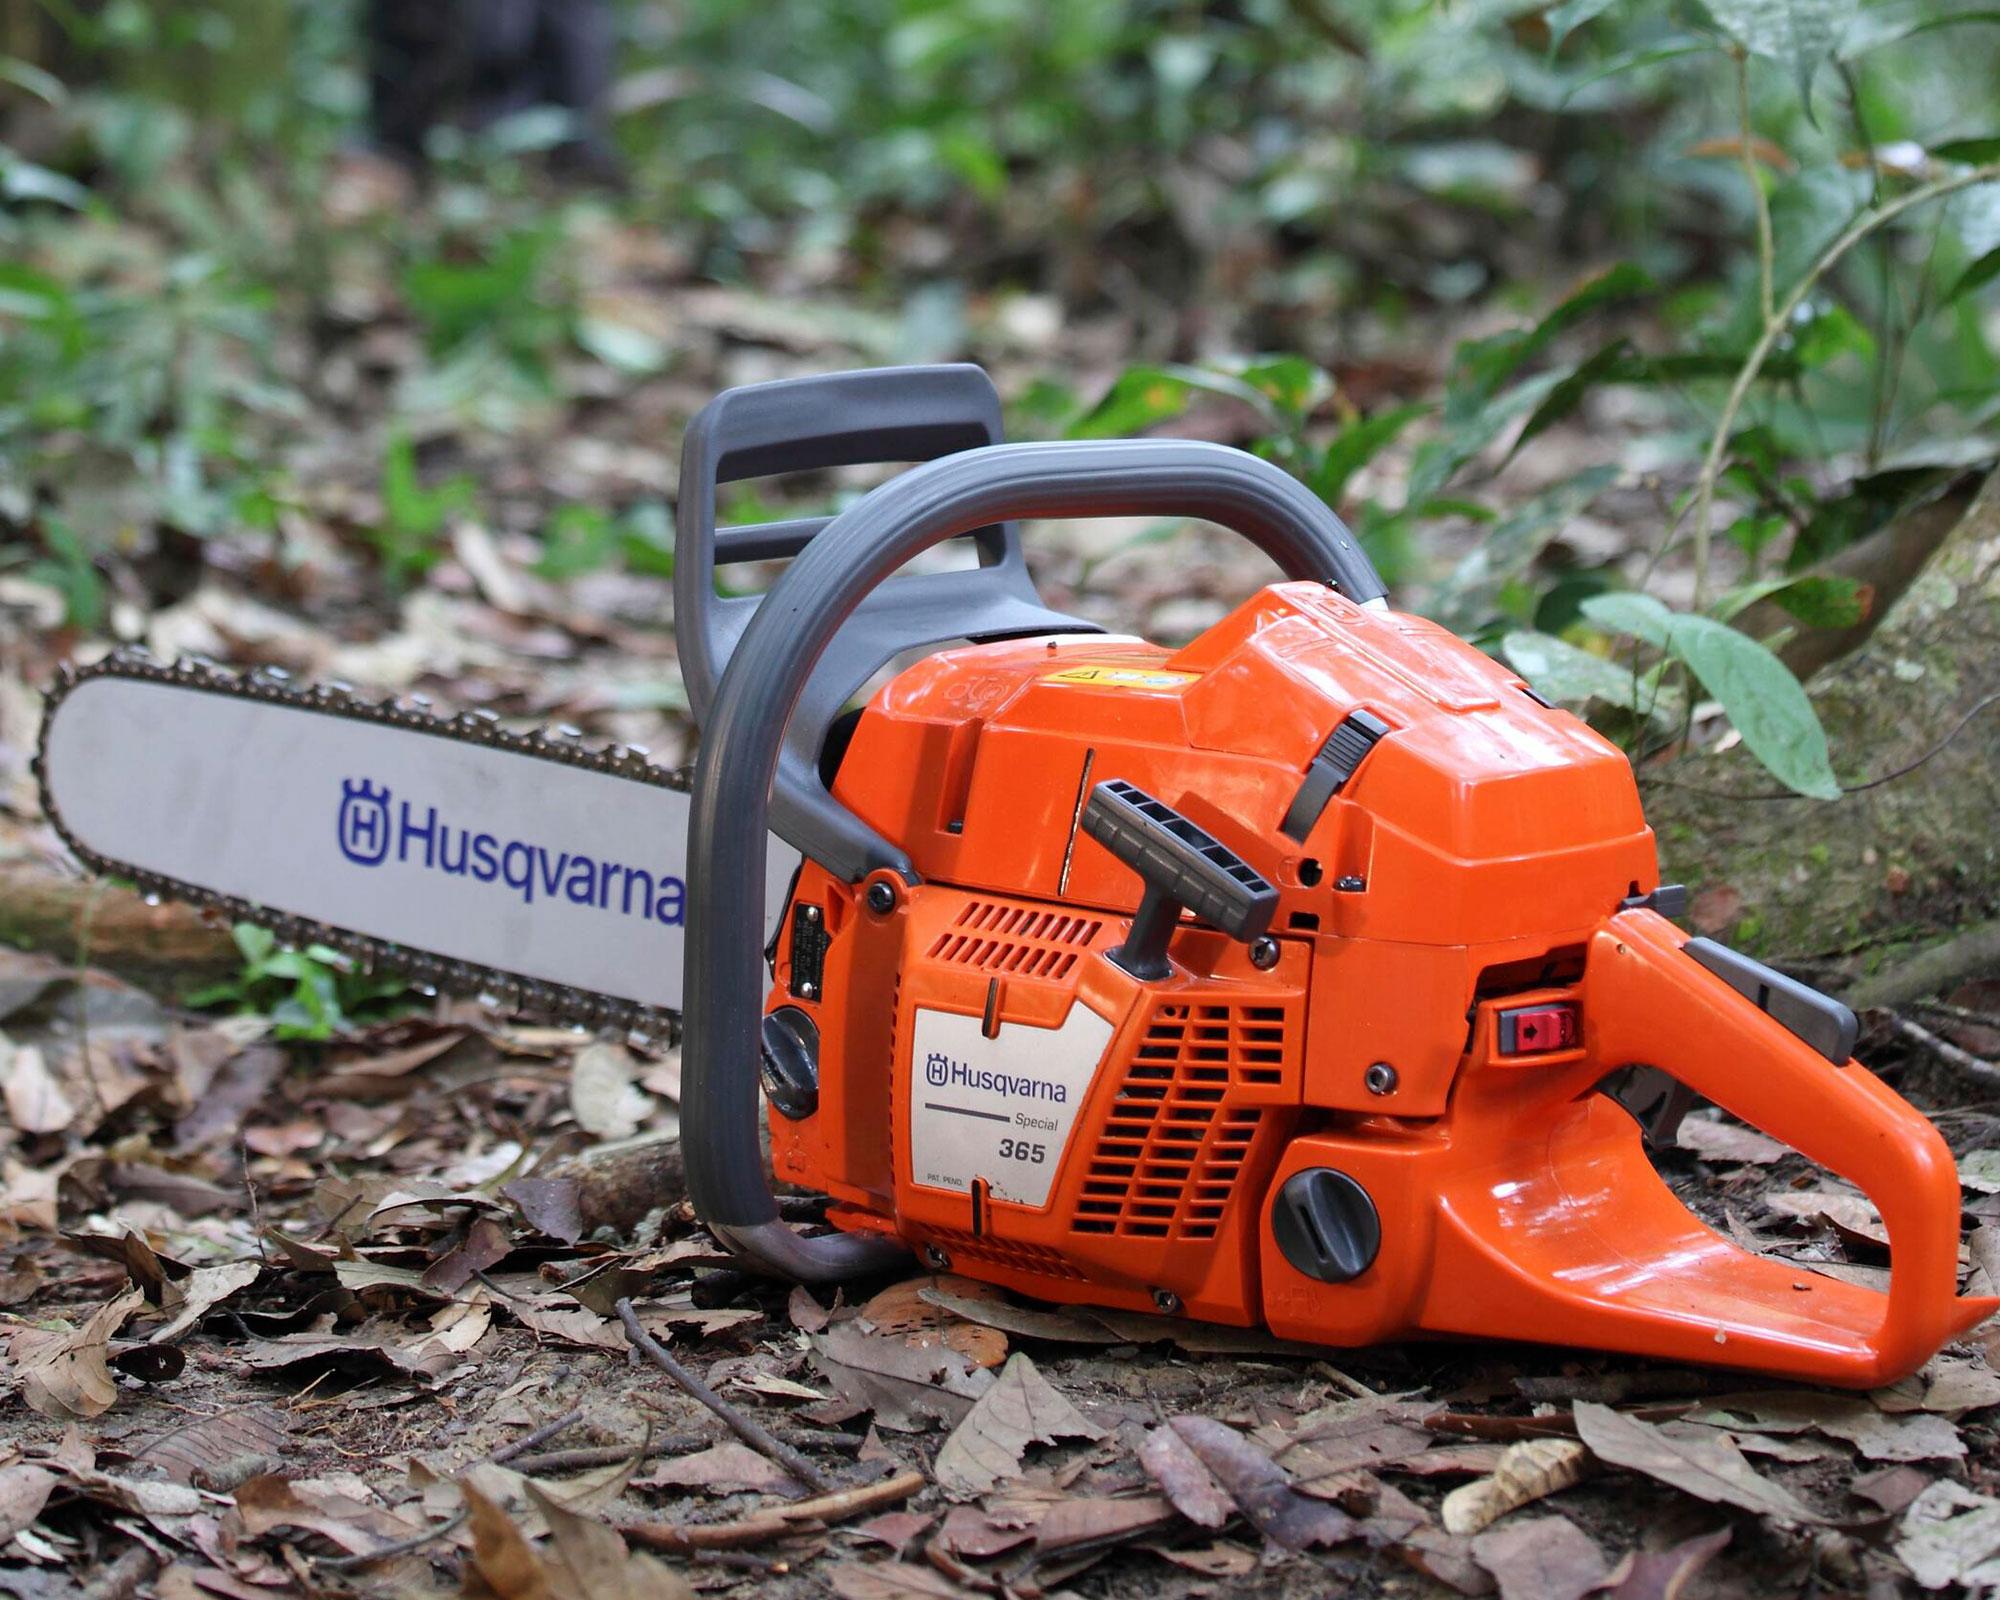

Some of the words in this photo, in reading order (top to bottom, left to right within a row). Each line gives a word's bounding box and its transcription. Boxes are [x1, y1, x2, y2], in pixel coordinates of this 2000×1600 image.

[398, 801, 686, 927] Husqvarna
[951, 1061, 1066, 1103] Husqvarna
[1015, 1112, 1058, 1131] Special
[999, 1138, 1046, 1164] 365
